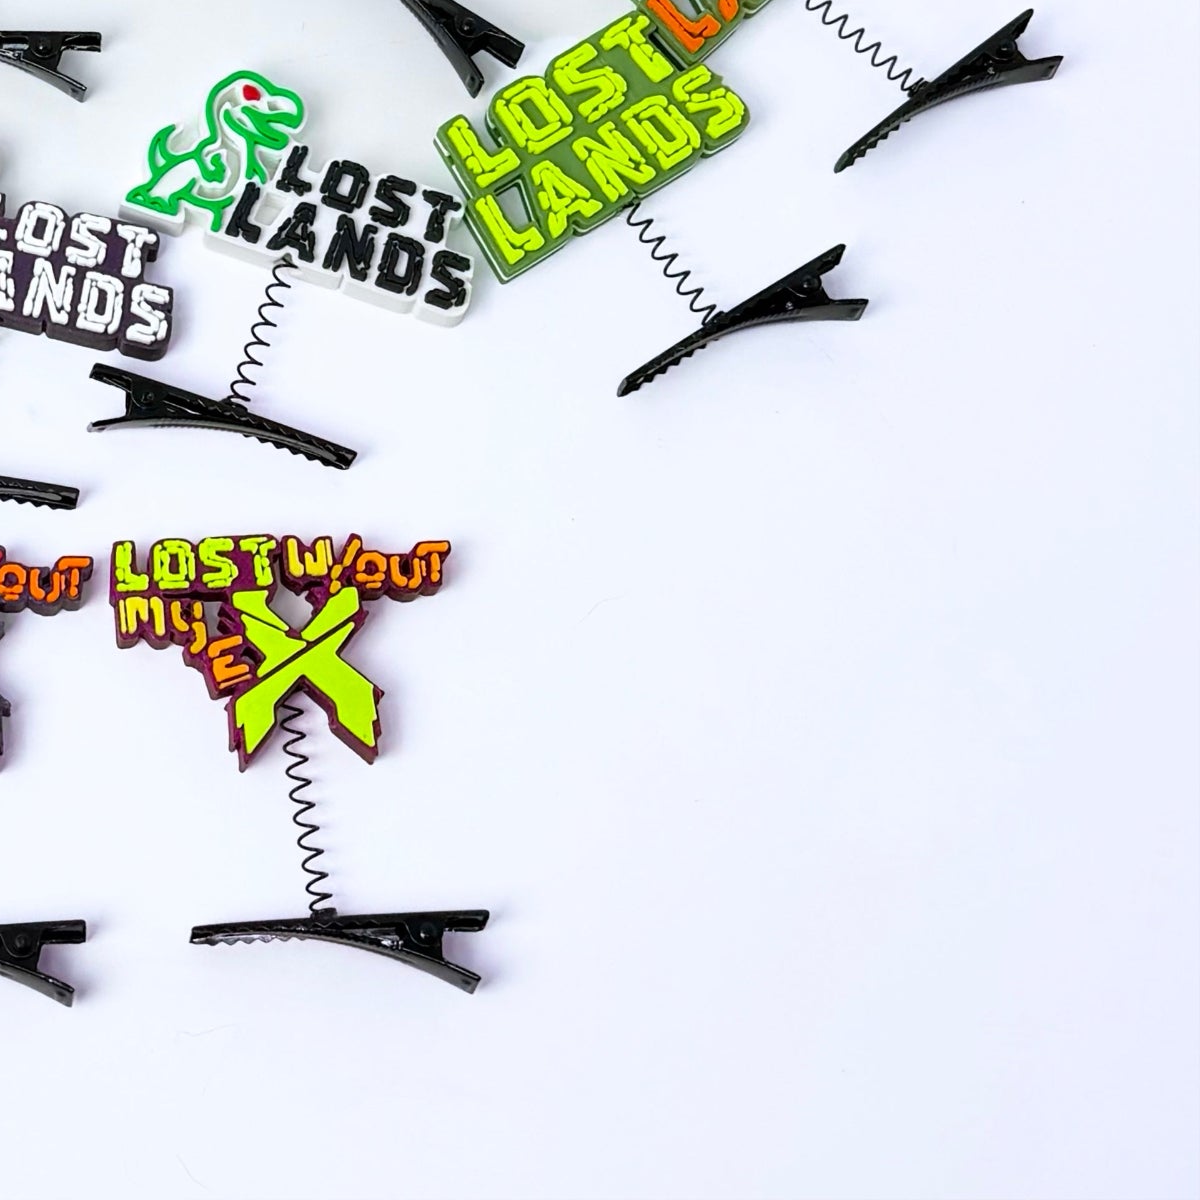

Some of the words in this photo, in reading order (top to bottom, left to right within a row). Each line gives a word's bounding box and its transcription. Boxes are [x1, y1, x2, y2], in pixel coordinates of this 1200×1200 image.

[449, 13, 674, 188] LOST
[275, 145, 462, 242] LOST
[476, 64, 748, 265] LANDS
[226, 182, 471, 309] LANDS
[115, 536, 277, 591] LOST
